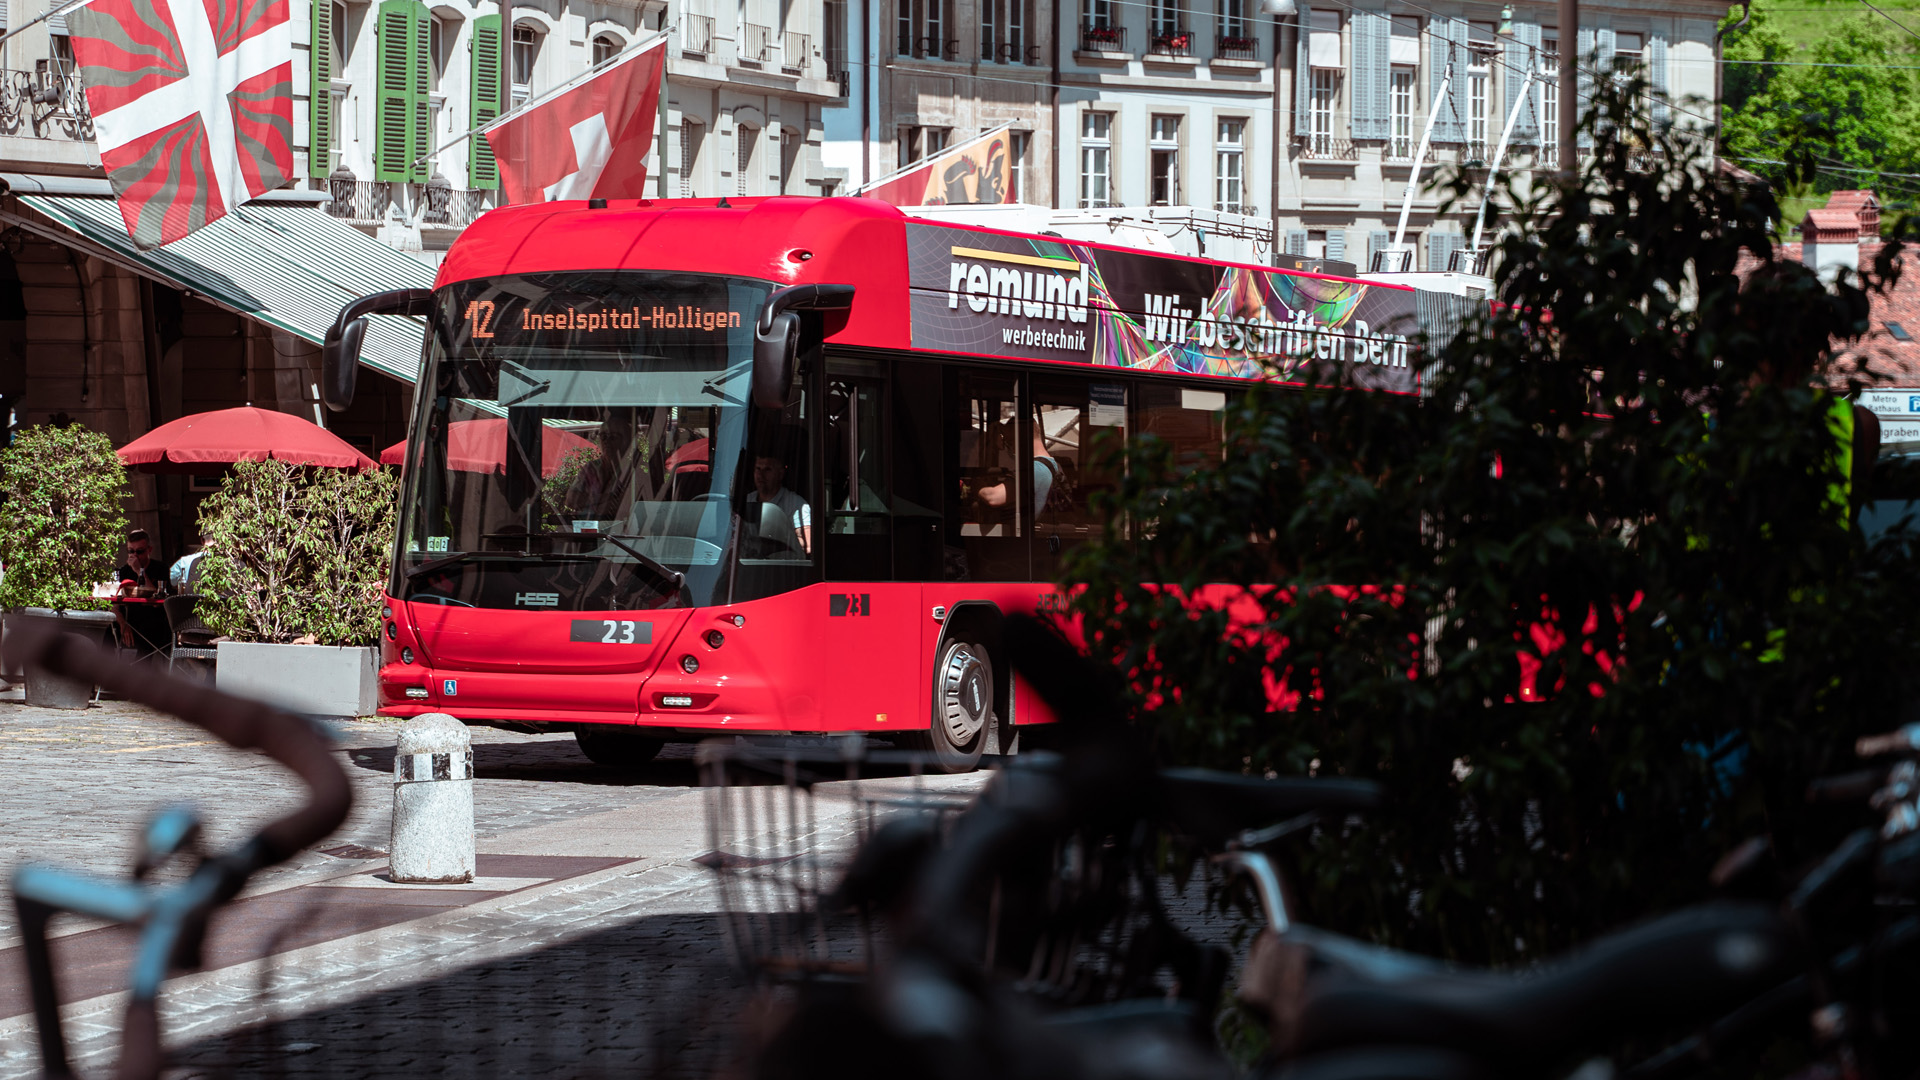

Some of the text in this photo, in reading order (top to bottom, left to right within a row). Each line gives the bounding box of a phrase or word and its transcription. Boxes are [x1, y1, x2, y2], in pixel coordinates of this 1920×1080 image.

[948, 262, 1090, 324] remund
[464, 300, 742, 339] 12 Inselspital-Holligen
[1144, 293, 1408, 368] Wir beschriften Bern
[1002, 324, 1087, 351] werbetechnik
[1872, 395, 1898, 403] Metro
[514, 592, 560, 607] HESS
[845, 594, 862, 617] 23
[601, 619, 636, 645] 23
